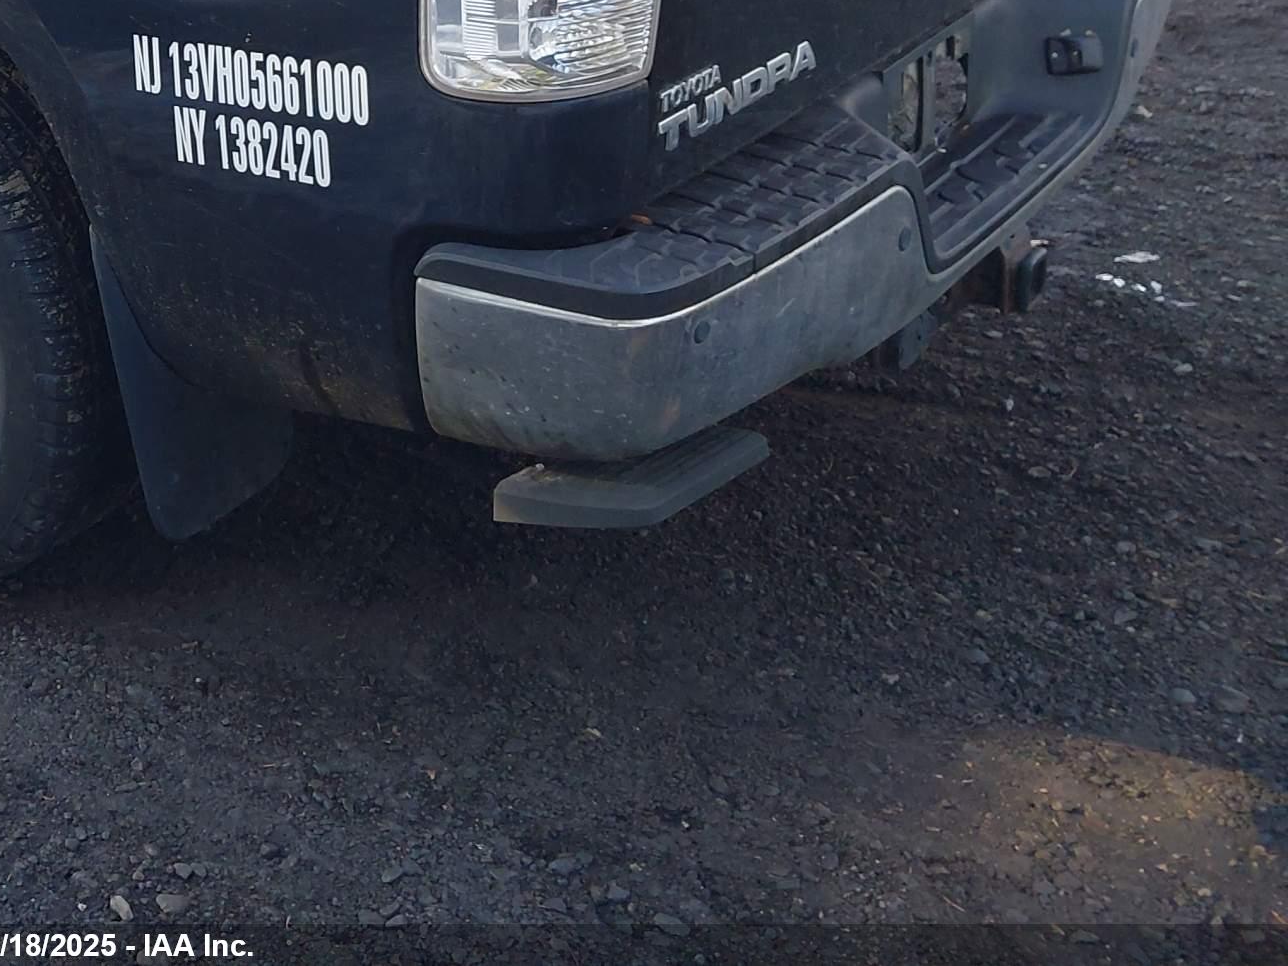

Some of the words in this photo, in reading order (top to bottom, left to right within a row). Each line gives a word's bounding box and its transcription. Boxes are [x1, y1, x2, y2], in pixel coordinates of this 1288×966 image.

[132, 34, 161, 95] NJ
[168, 41, 370, 126] 13VH05661000
[658, 40, 816, 152] TUNDRA
[660, 64, 721, 112] TOYOTA
[173, 105, 207, 166] NY
[215, 114, 332, 188] 1382420
